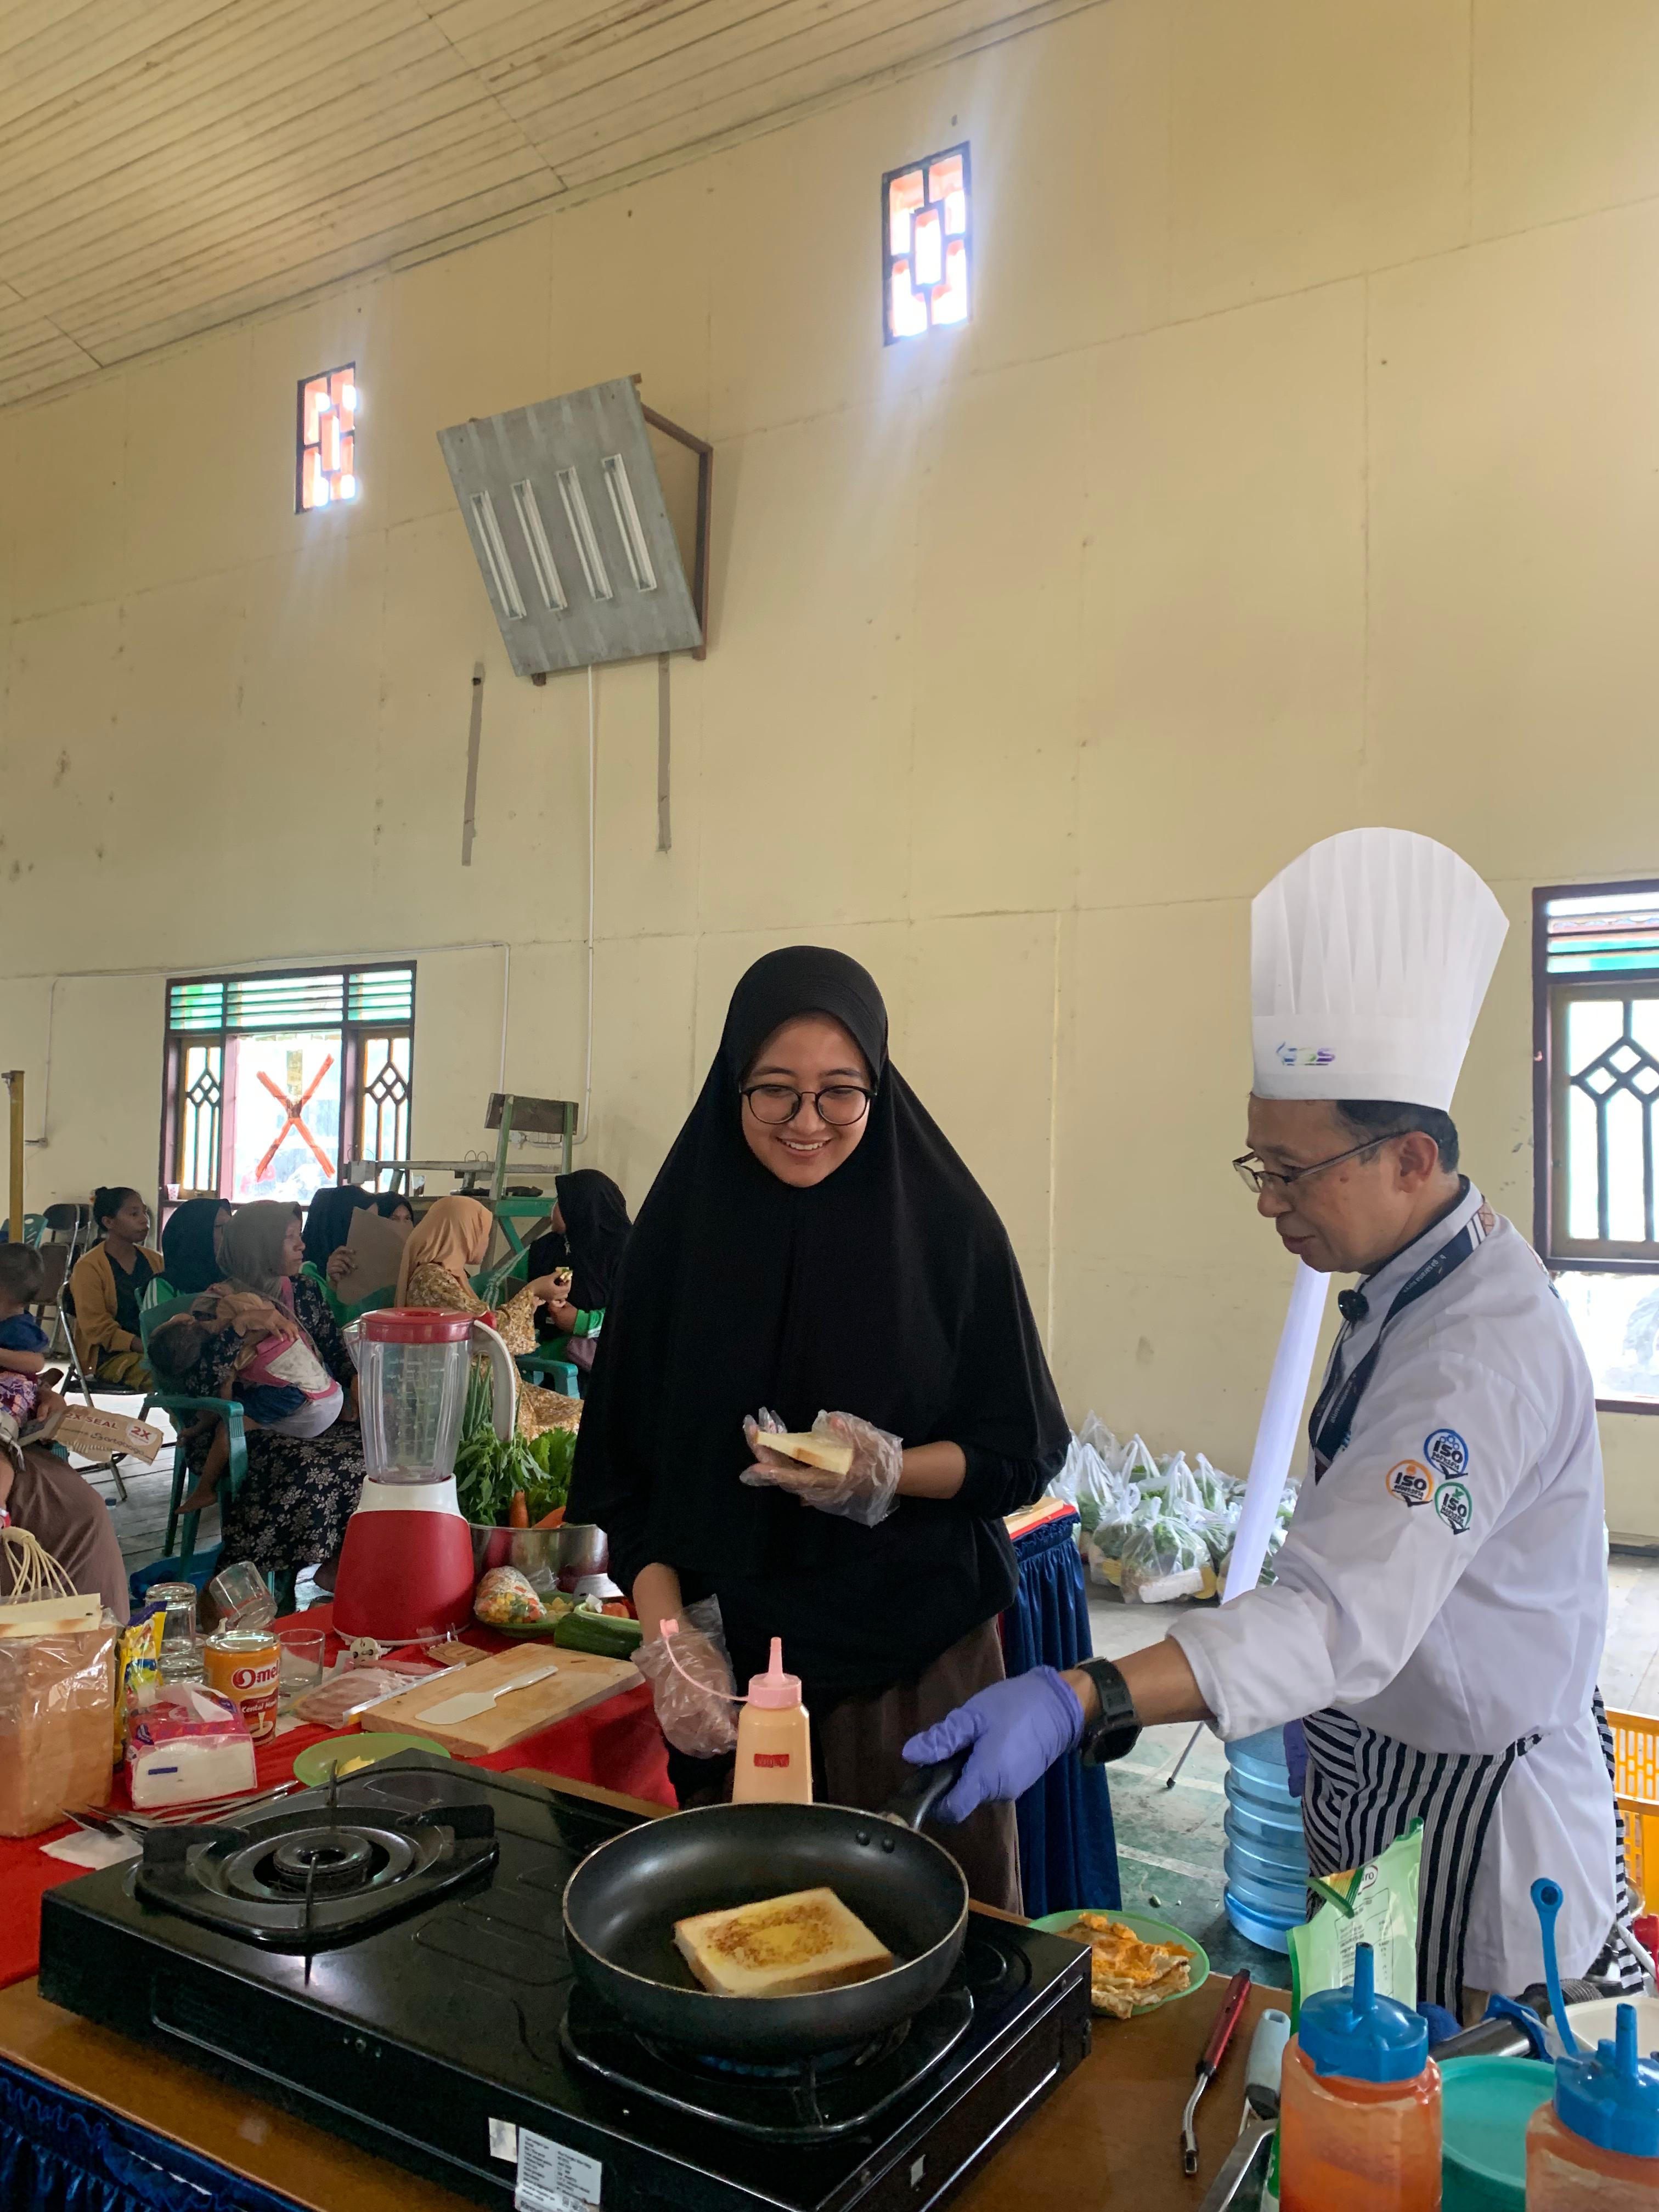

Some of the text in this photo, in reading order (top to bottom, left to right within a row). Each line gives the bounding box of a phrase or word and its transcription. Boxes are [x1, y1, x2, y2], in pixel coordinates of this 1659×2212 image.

[86, 1417, 118, 1430] SEAL
[131, 1426, 152, 1440] 2X
[1432, 1440, 1463, 1464] ISO
[1394, 1472, 1427, 1491] ISO
[1442, 1493, 1467, 1517] ISO
[232, 1659, 280, 1690] Omel
[242, 1702, 263, 1713] Kental
